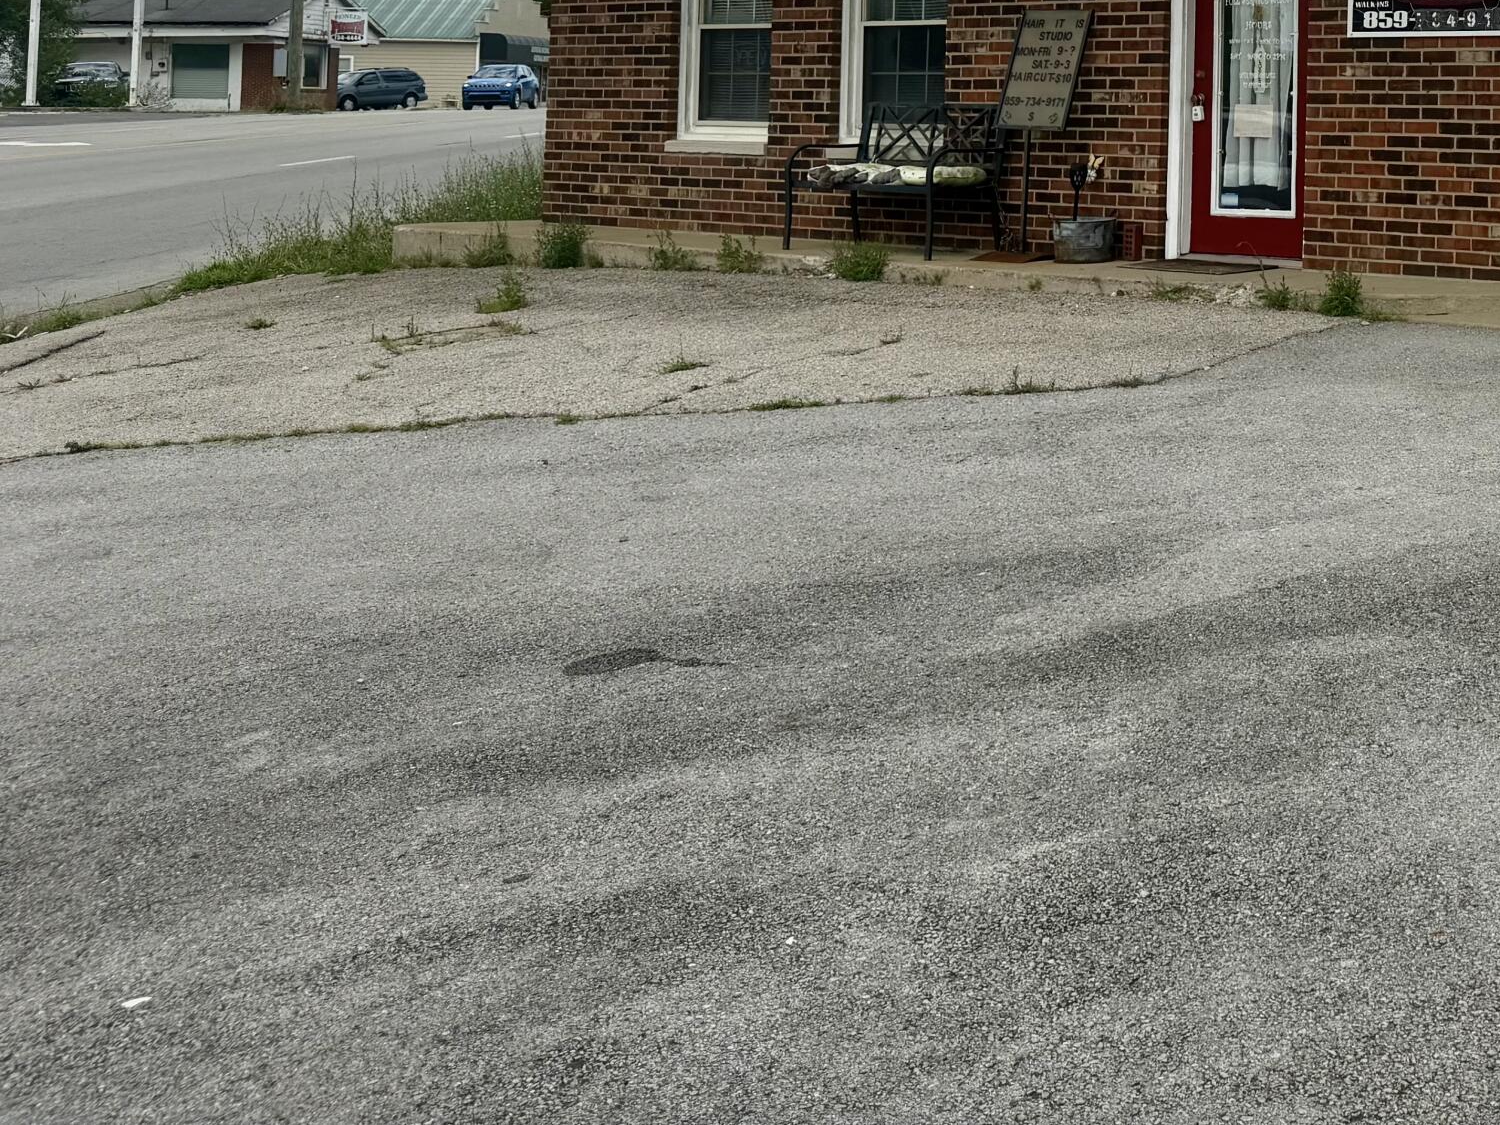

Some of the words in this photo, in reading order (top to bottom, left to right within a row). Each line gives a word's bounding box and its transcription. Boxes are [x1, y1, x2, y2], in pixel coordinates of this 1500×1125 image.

[1024, 19, 1045, 28] HAIR
[1055, 19, 1066, 28] IT
[1075, 19, 1085, 28] IS
[1039, 31, 1073, 41] STUDIO
[1005, 96, 1066, 107] 859-734-9171
